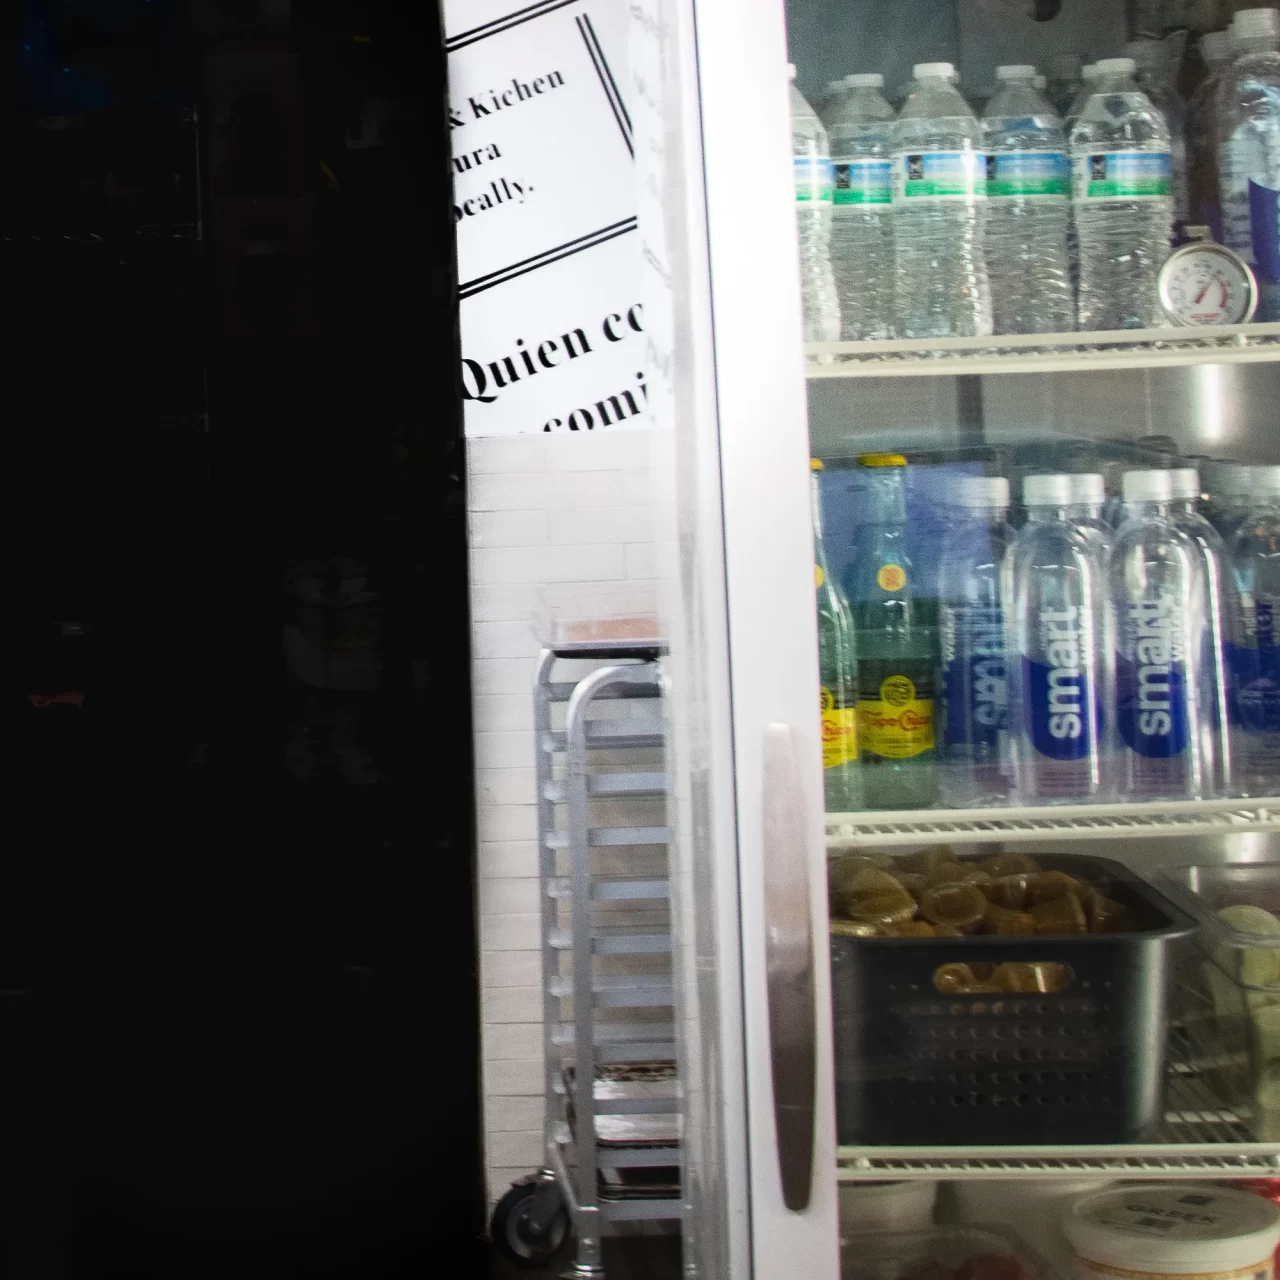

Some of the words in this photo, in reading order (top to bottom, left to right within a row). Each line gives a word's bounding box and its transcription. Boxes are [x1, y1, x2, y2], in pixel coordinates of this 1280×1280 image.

[469, 70, 567, 120] Kichen
[460, 325, 593, 403] Quien
[1039, 604, 1083, 740] smart
[1126, 599, 1173, 737] smart
